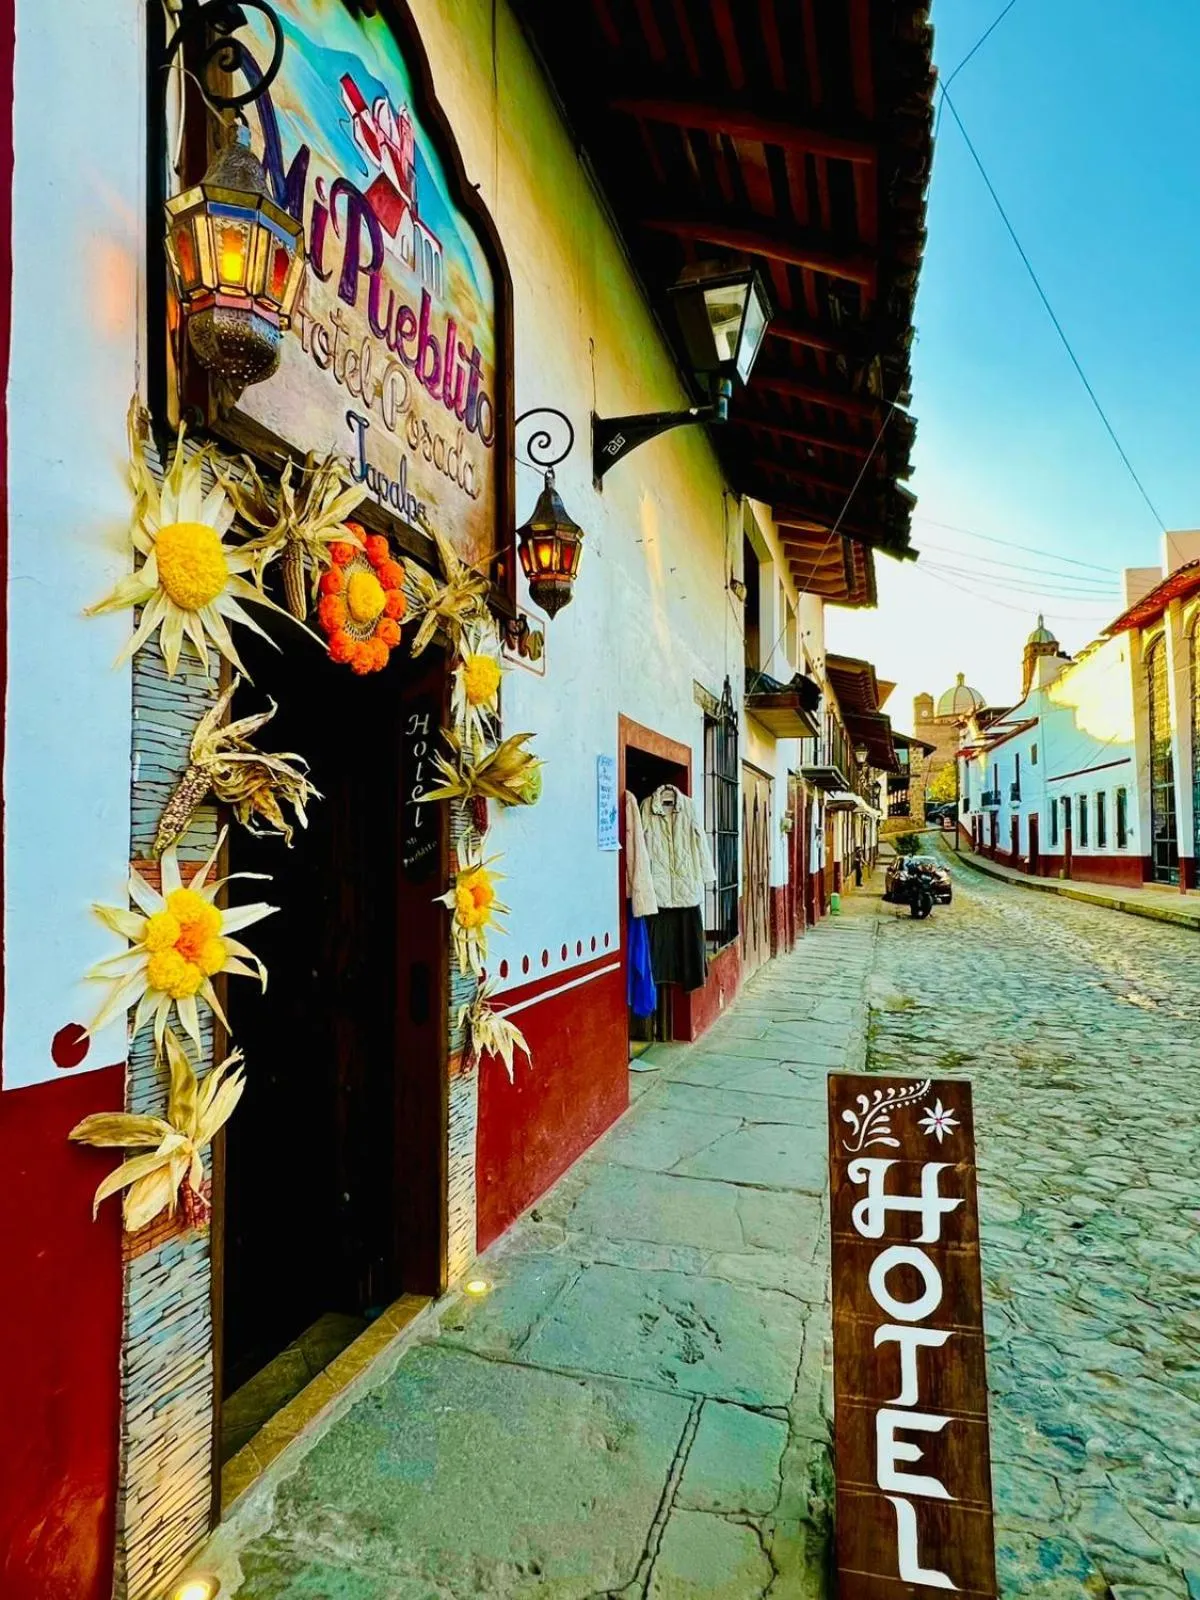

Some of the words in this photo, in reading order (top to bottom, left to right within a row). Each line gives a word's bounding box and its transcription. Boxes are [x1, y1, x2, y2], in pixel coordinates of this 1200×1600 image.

[329, 177, 494, 448] Pueblito
[382, 360, 481, 500] Posada
[847, 1158, 966, 1591] HOTEL
